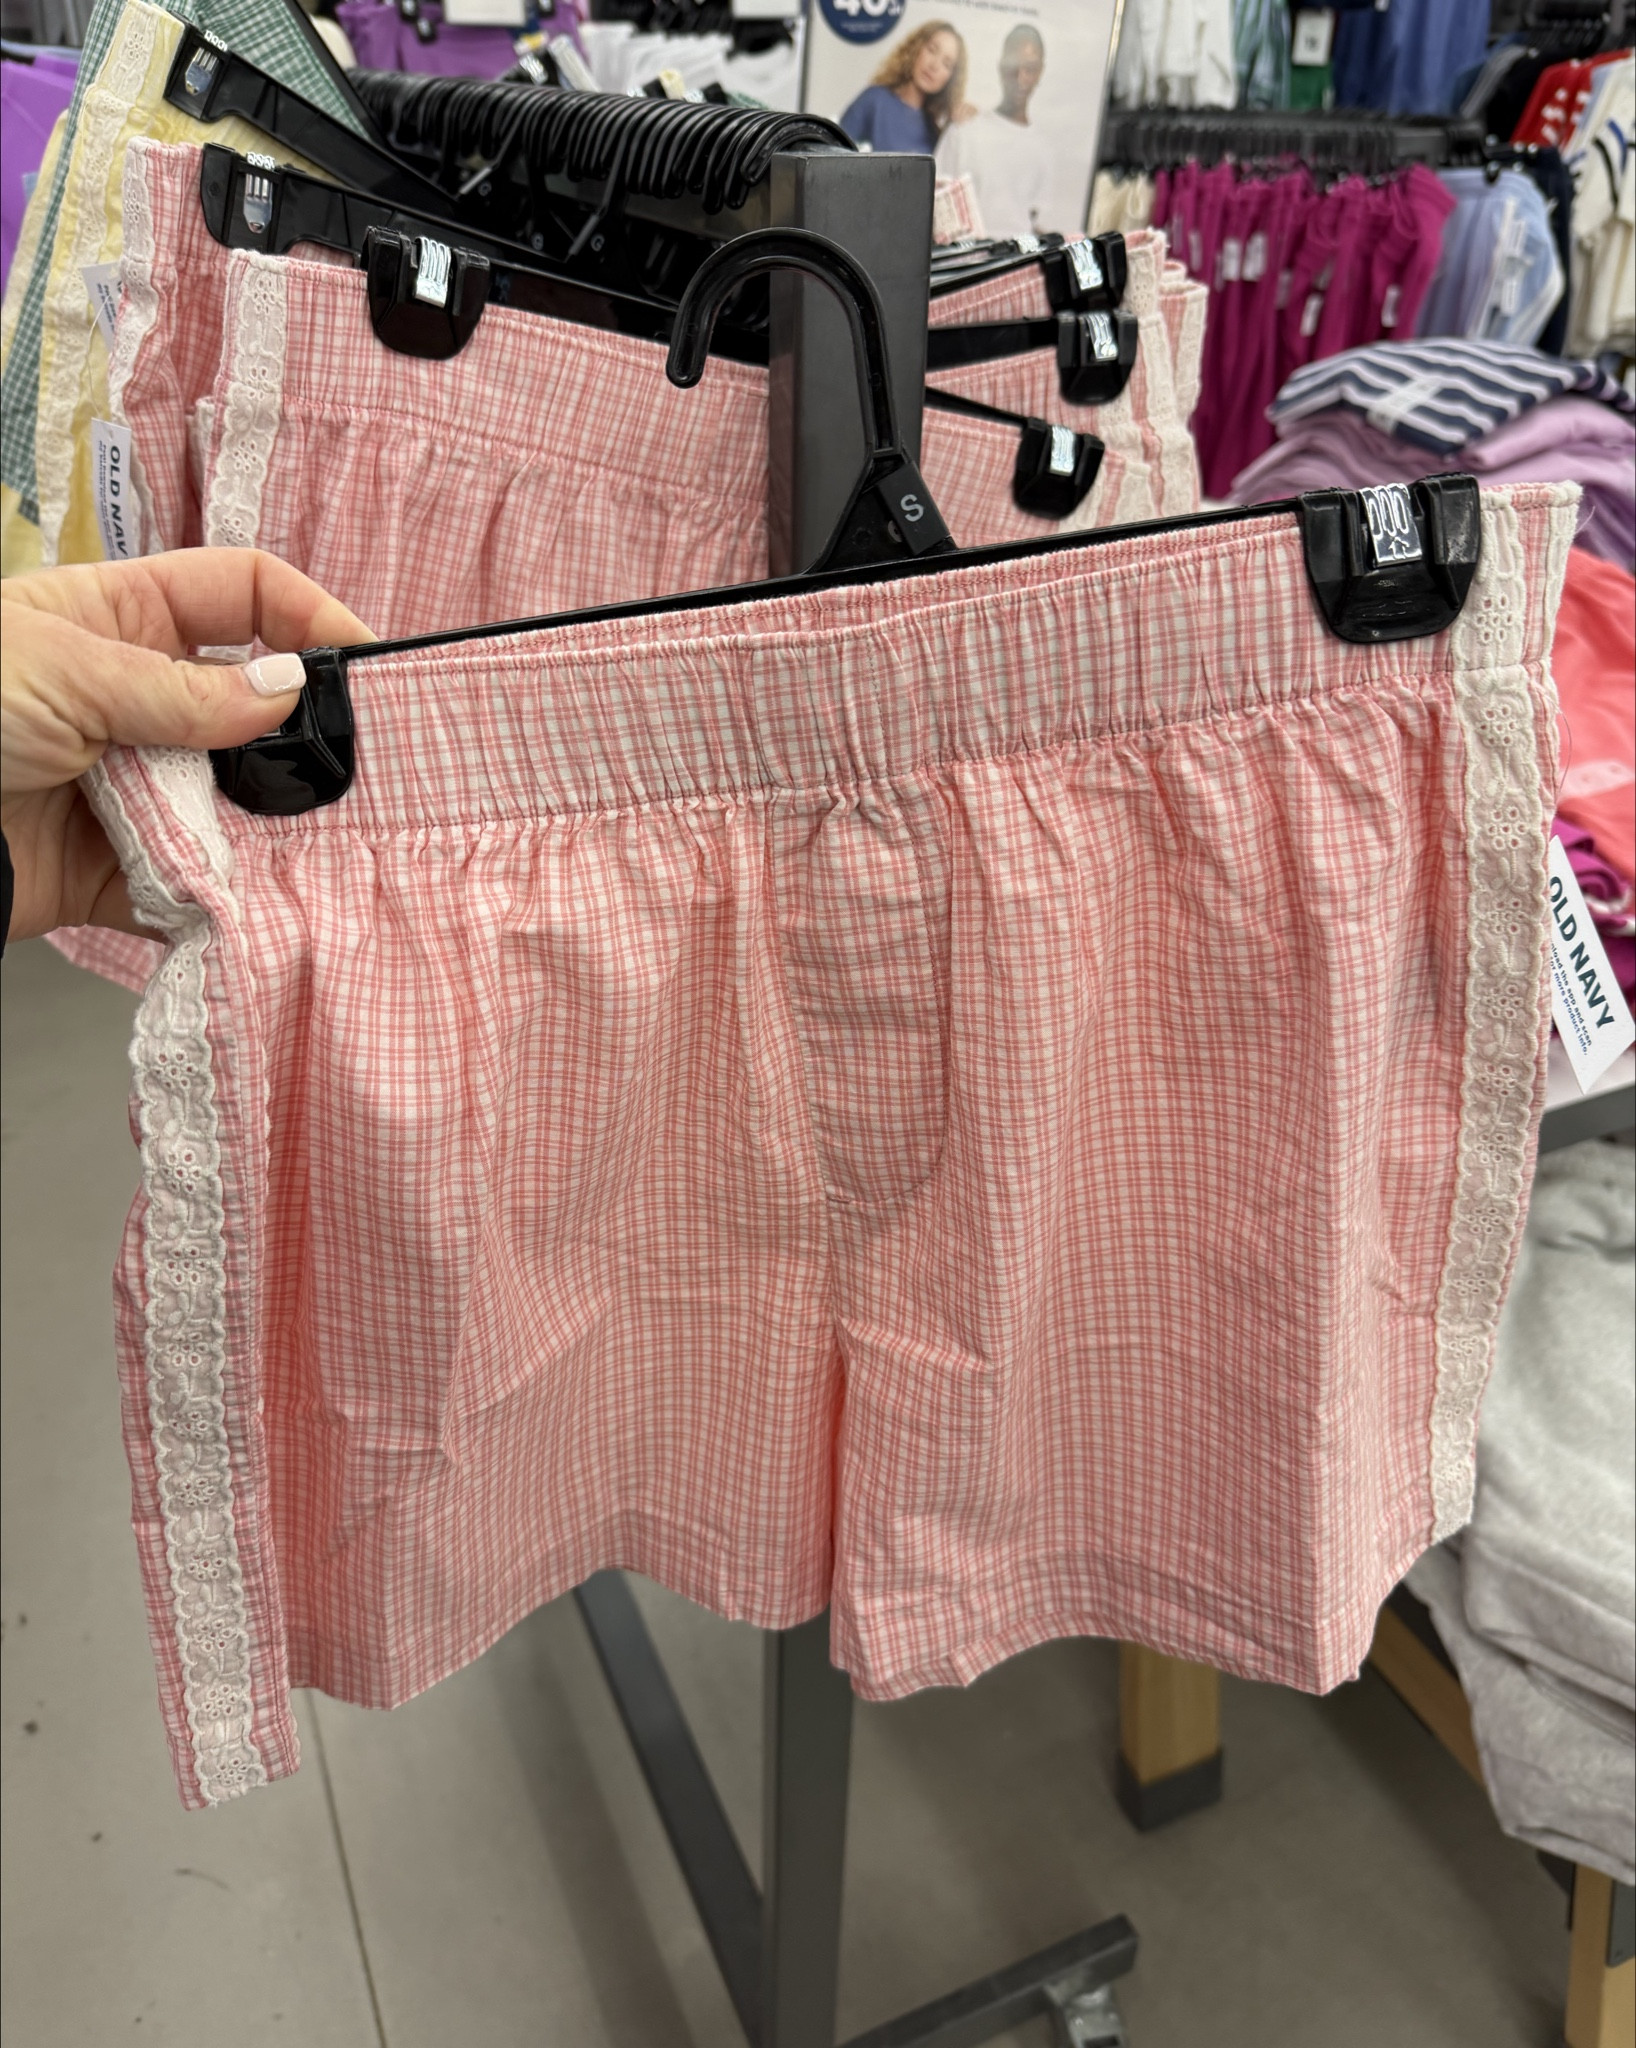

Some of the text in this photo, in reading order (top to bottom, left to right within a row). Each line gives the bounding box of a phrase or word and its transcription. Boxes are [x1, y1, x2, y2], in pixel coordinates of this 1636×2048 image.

[110, 445, 128, 558] OLD NAV
[900, 493, 925, 522] S
[1550, 876, 1615, 1028] OLD NAVY
[1554, 972, 1566, 996] more
[1563, 998, 1580, 1034] product
[1578, 1033, 1587, 1055] info.
[1567, 988, 1576, 1005] app
[1574, 1007, 1584, 1024] and
[1581, 1025, 1592, 1046] scan
